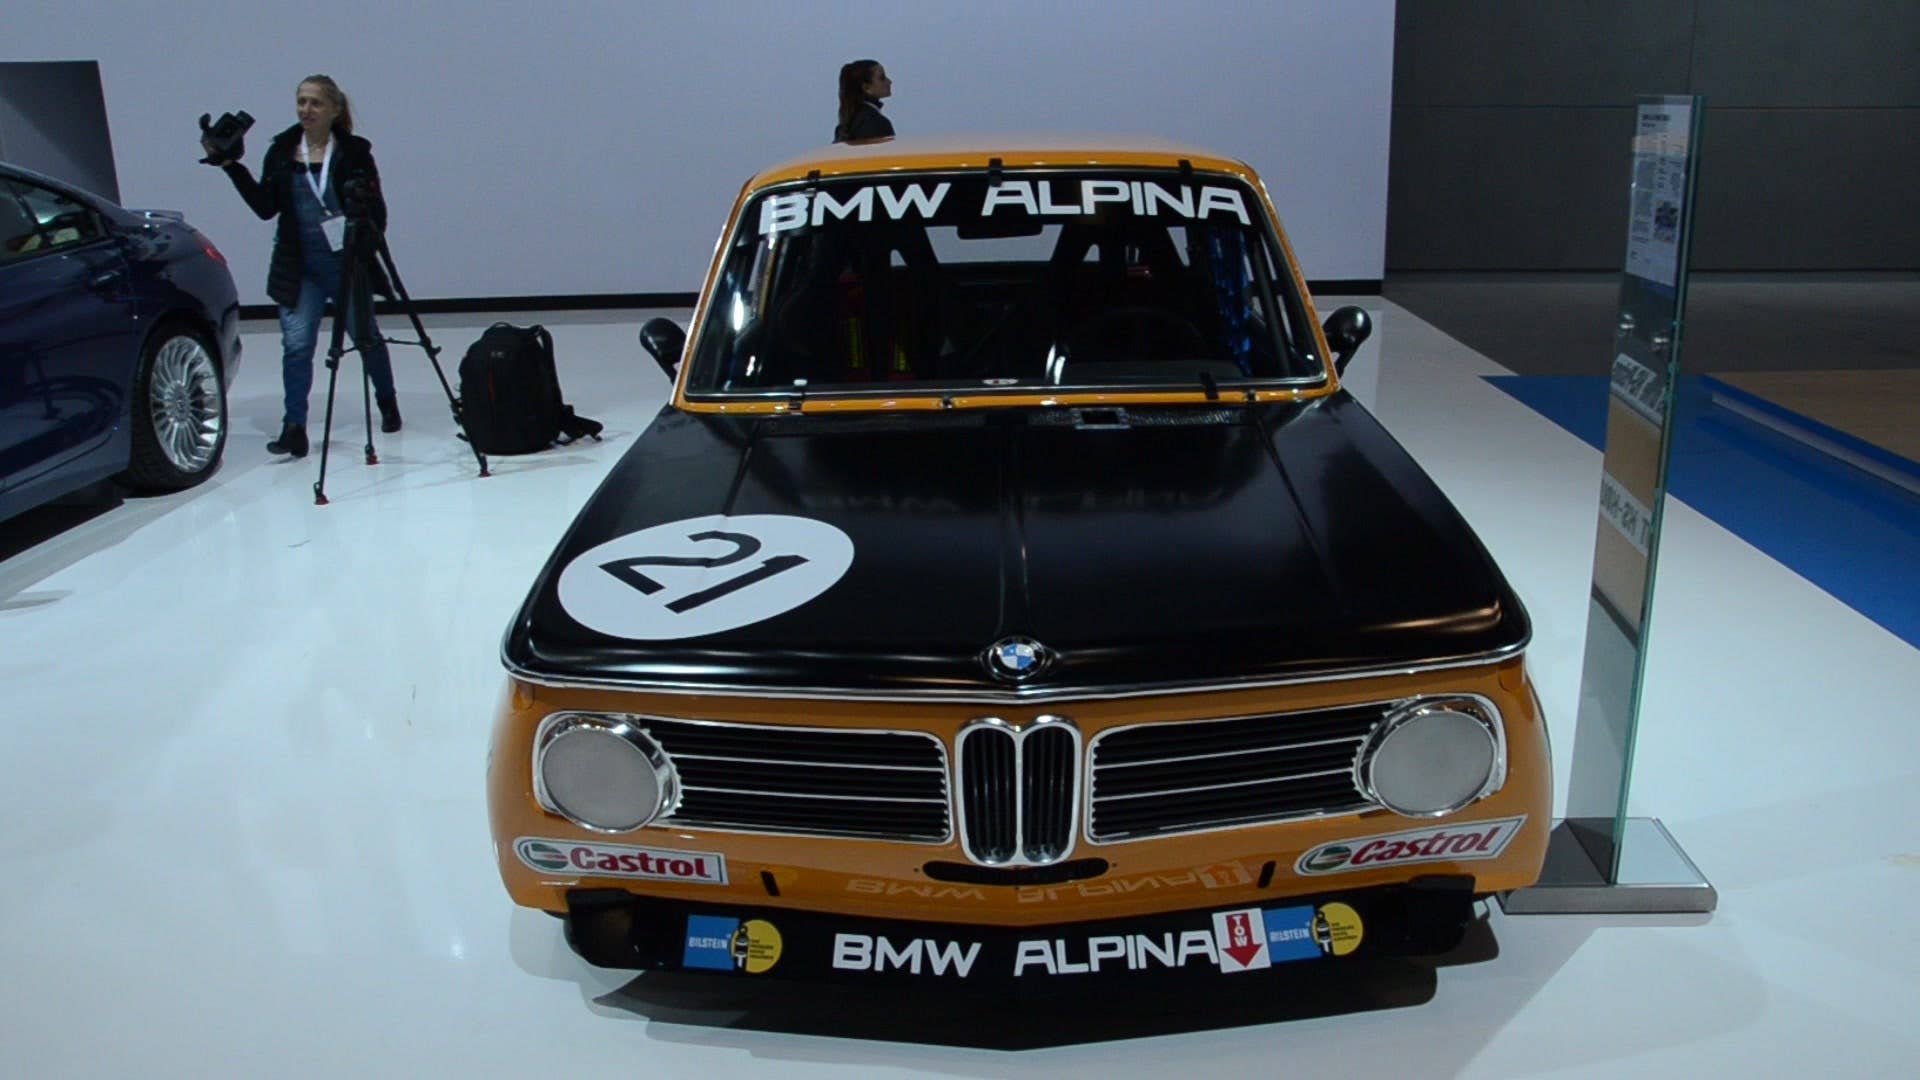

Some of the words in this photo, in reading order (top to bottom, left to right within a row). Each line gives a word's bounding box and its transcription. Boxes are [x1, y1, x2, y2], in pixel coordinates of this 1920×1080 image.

[759, 183, 951, 235] BMW
[982, 180, 1251, 225] ALPINA
[598, 530, 809, 614] 21
[570, 847, 711, 879] Castrol
[1351, 826, 1500, 866] Castrol
[688, 936, 728, 950] BILSTEIN
[1231, 915, 1248, 947] TOW
[832, 933, 981, 976] BMW
[1013, 930, 1219, 976] ALPINA
